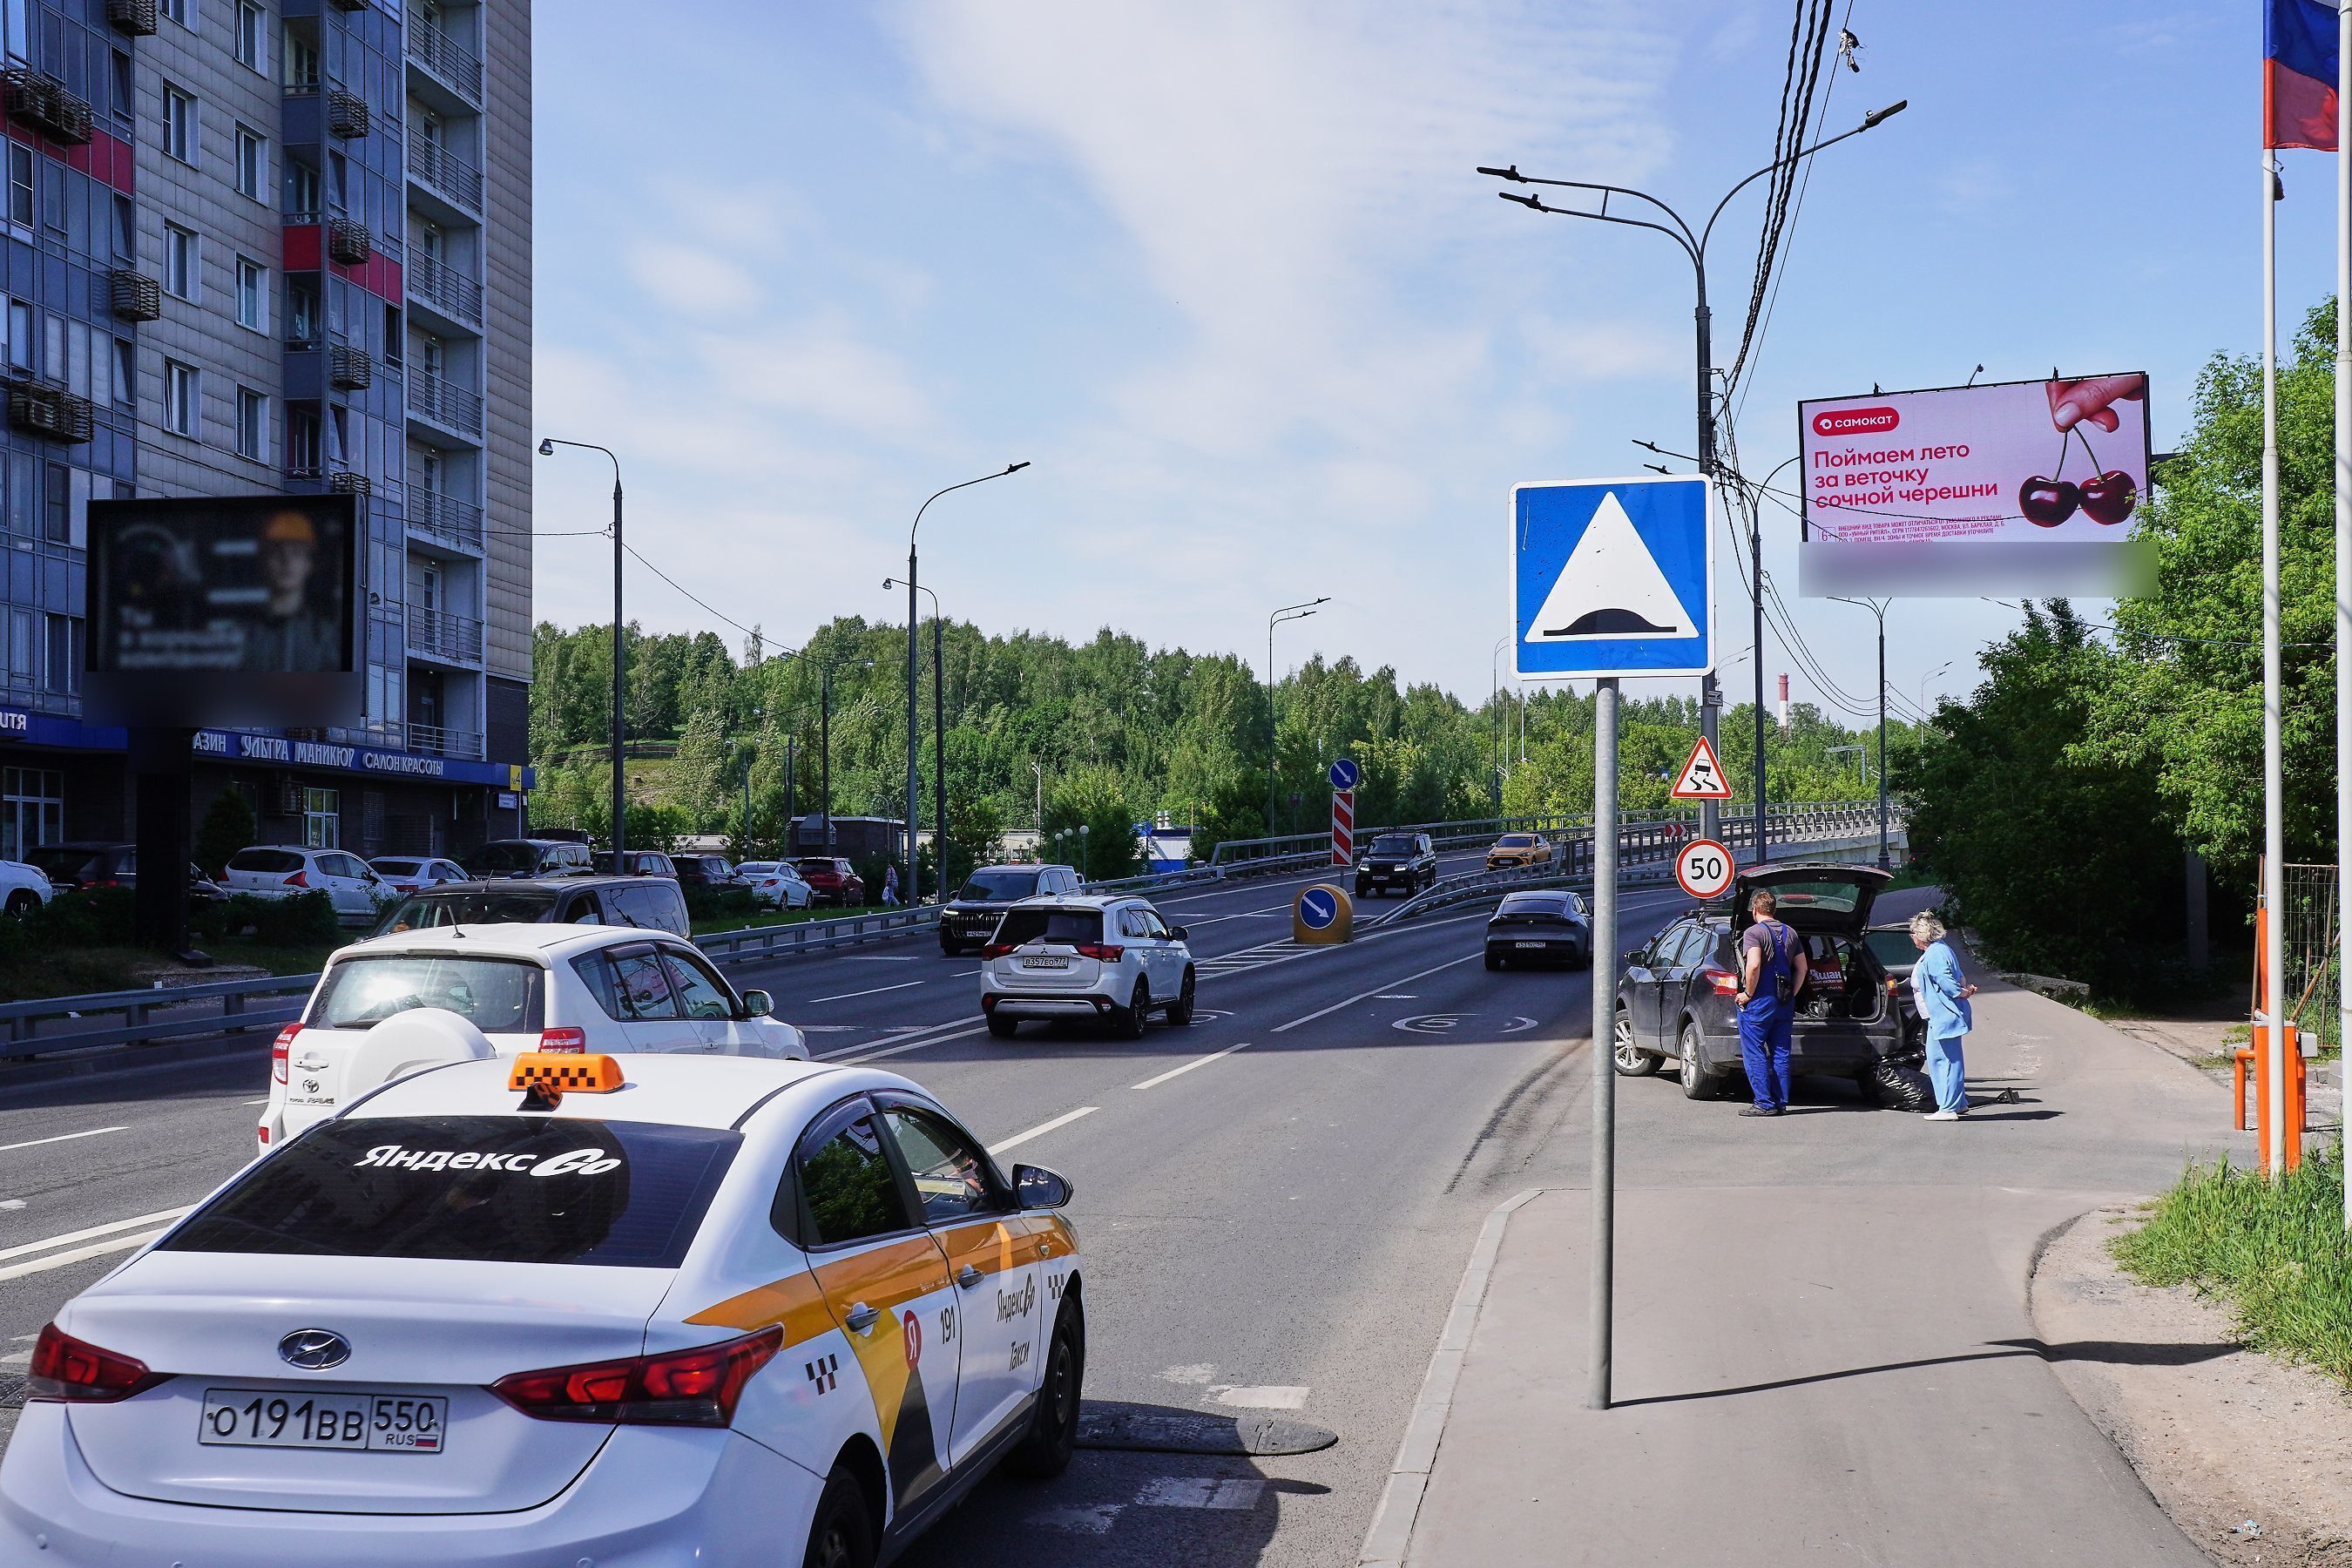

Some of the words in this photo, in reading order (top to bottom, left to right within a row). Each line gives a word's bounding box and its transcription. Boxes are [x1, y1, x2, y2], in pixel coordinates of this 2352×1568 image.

[1835, 416, 1893, 428] самокат
[1815, 448, 1915, 469] Поймаем
[1920, 444, 1970, 461] лето
[1815, 474, 1839, 489] за
[1845, 468, 1930, 486] веточку
[1815, 485, 1894, 509] сочной
[1898, 483, 1998, 505] черешни
[294, 741, 355, 767] МАНИКЮР
[362, 752, 400, 772] САЛОН
[402, 757, 443, 775] КРАСОТЫ
[1690, 856, 1722, 881] 50
[940, 1305, 956, 1345] 191
[1009, 1341, 1031, 1372] Такси
[384, 1432, 416, 1446] RUS
